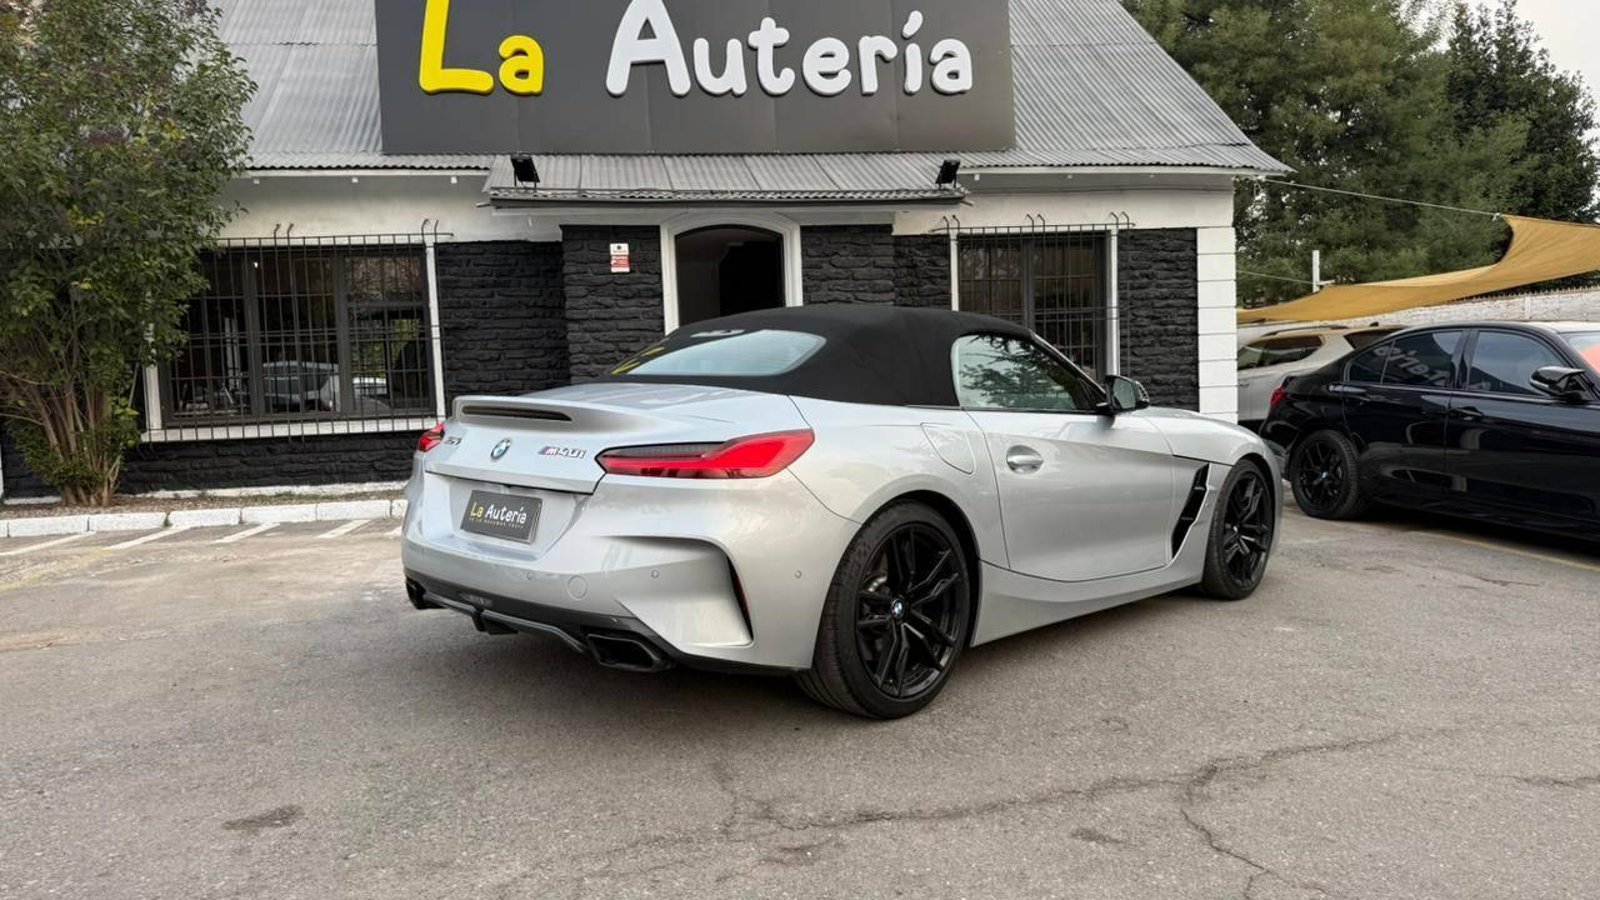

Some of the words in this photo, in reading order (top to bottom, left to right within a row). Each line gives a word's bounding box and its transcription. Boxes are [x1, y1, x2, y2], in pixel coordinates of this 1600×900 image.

[419, 0, 545, 95] La
[606, 0, 973, 96] Autería
[470, 502, 484, 518] La
[484, 504, 527, 524] Autería
